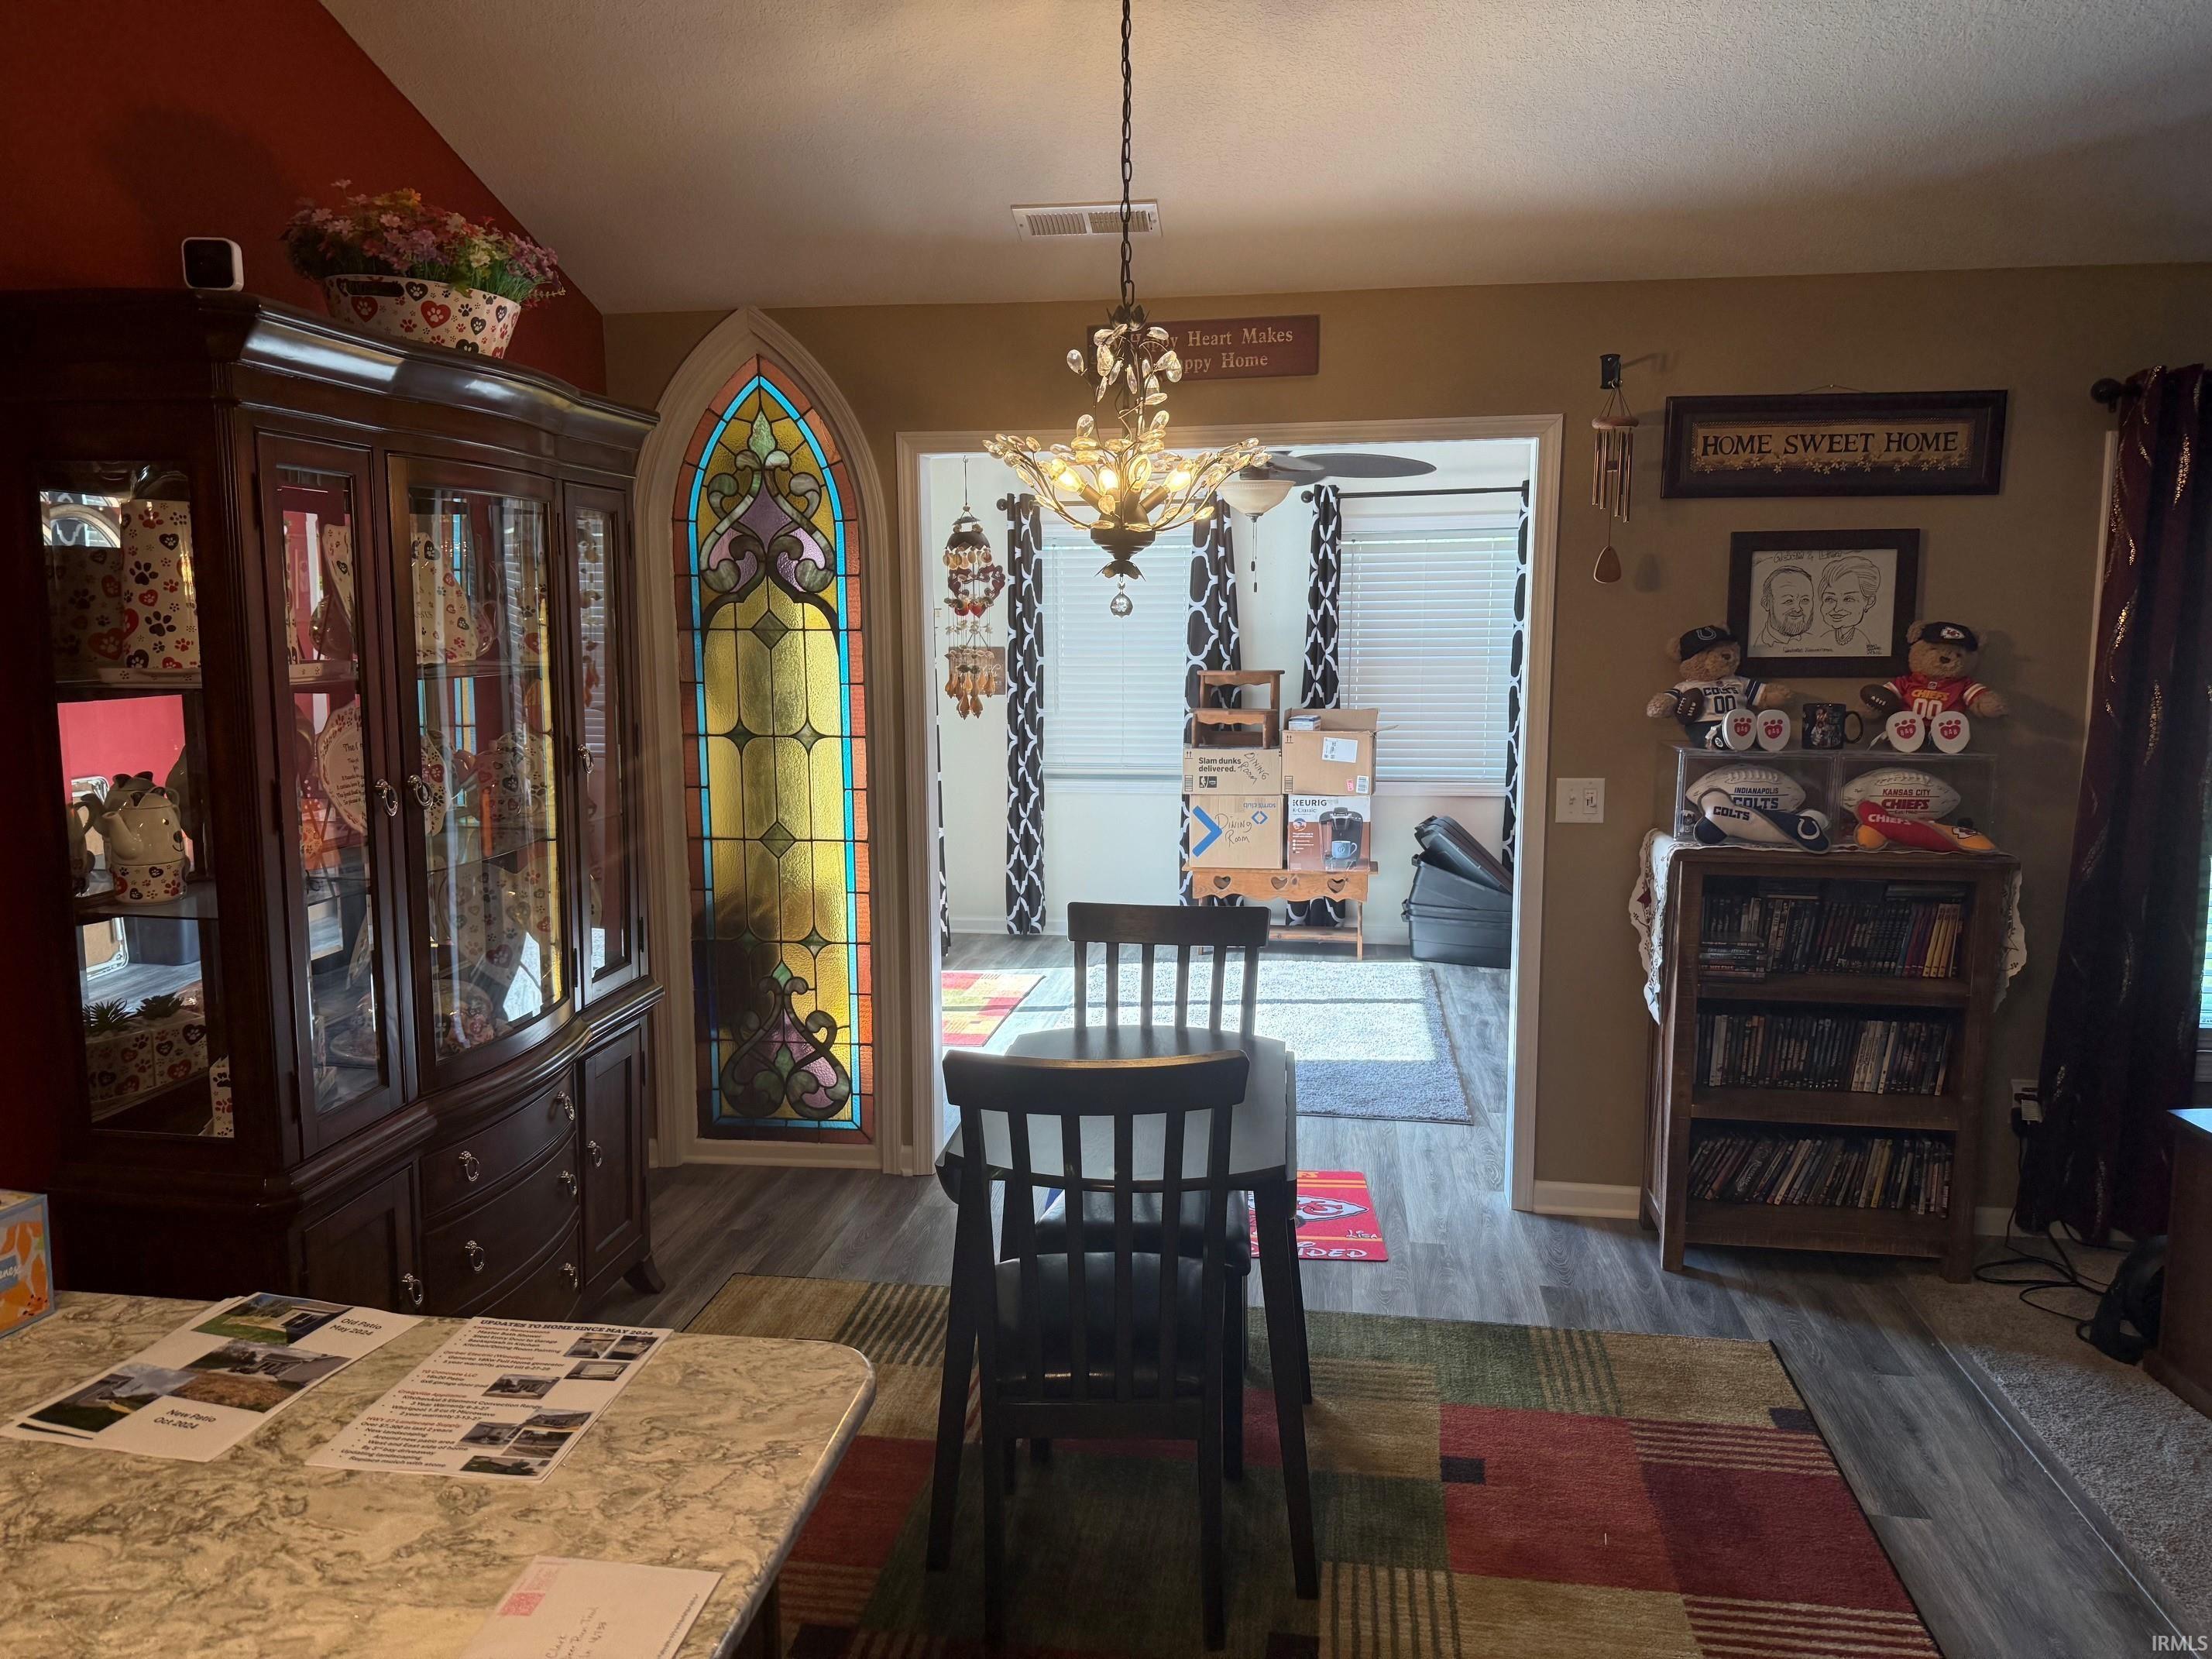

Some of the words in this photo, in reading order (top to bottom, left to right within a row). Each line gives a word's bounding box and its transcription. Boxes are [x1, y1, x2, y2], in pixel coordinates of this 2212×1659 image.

[1188, 331, 1232, 347] Heart
[1242, 327, 1293, 345] Makes
[1221, 352, 1269, 369] Home
[1701, 434, 1773, 457] HOME
[1784, 433, 1860, 455] SWEET
[1884, 431, 1959, 453] HOME
[1703, 687, 1740, 696] COLTS
[1911, 689, 1949, 701] CHIEFS
[1713, 695, 1736, 714] 00
[1912, 698, 1942, 720] 00
[1243, 752, 1270, 781] DINING
[1732, 796, 1779, 811] COLTS
[1881, 799, 1931, 810] CHIEFS
[1712, 805, 1750, 821] COLTS
[328, 1324, 351, 1333] May
[358, 1321, 383, 1330] Patio
[153, 1417, 174, 1425] Oct
[166, 1409, 191, 1418] New
[188, 1413, 217, 1423] Patio
